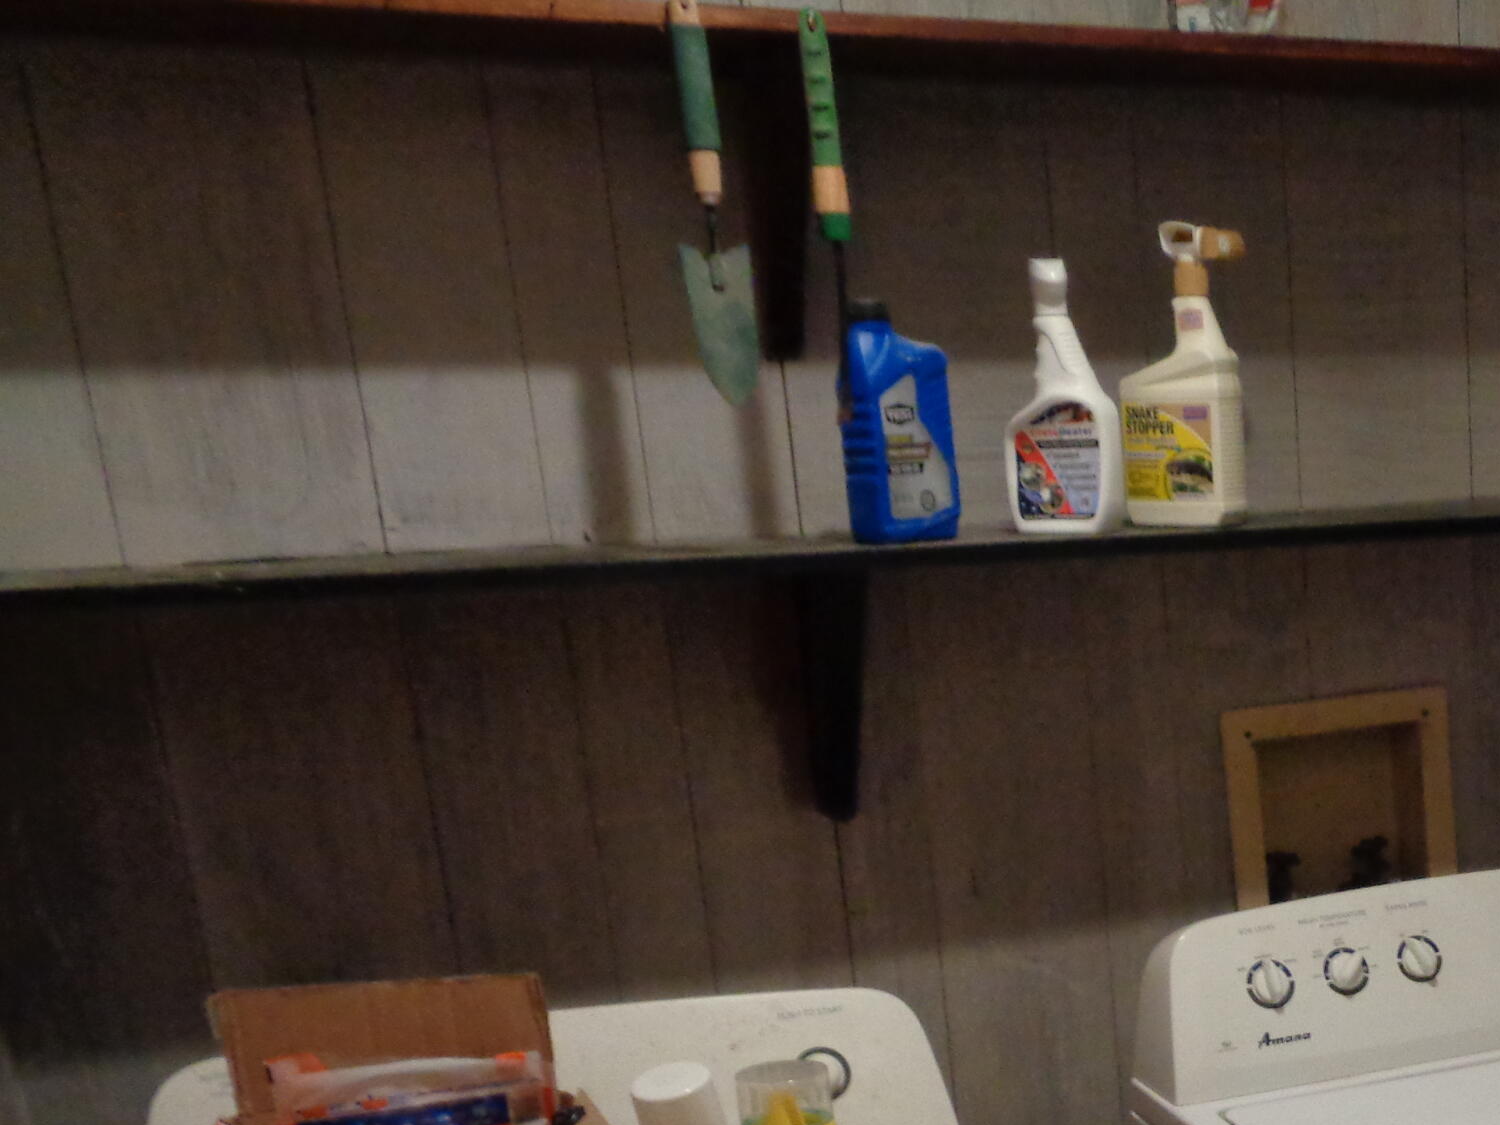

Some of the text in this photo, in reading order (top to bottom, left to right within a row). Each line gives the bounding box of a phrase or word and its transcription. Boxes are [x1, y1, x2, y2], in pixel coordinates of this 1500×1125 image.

[1125, 406, 1158, 420] SNAKE
[1125, 420, 1175, 435] STOPPER
[1258, 1031, 1312, 1049] Amana
